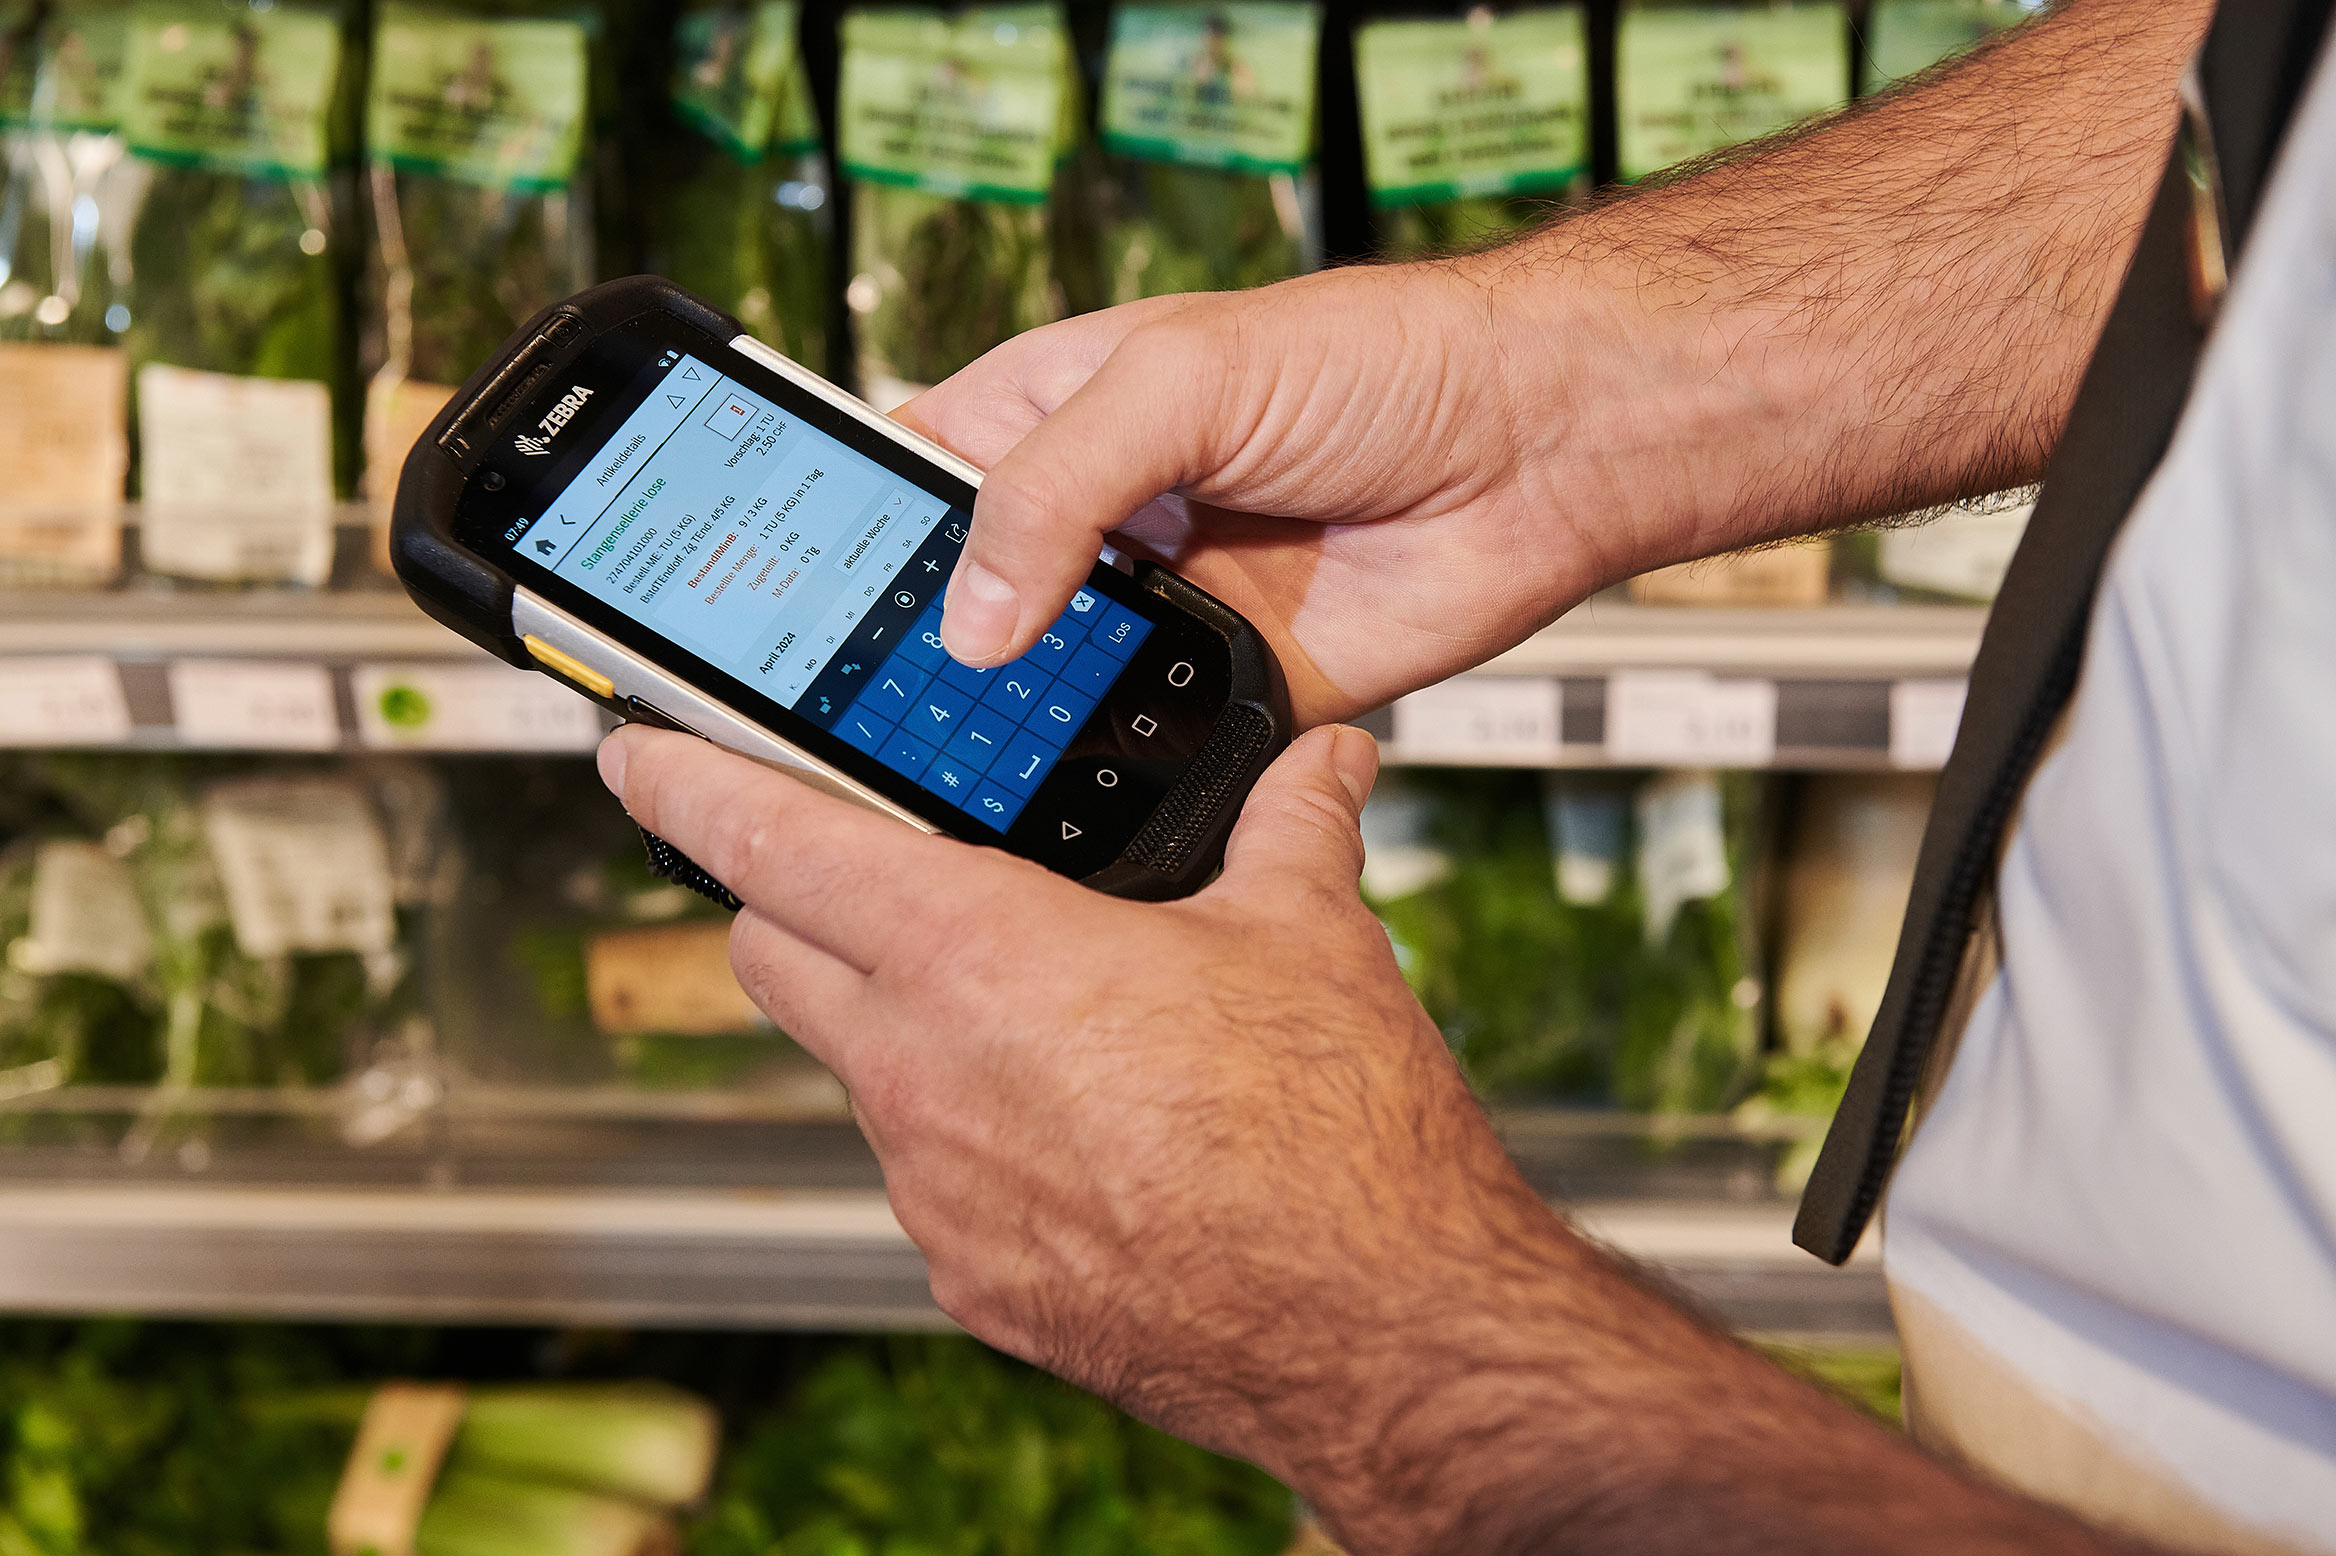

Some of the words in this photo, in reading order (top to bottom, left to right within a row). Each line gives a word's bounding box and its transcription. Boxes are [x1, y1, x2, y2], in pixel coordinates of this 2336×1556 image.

[538, 383, 595, 438] ZEBRA
[758, 411, 776, 426] TU
[754, 434, 778, 457] 2.50
[771, 419, 788, 437] CHF
[755, 424, 767, 433] 1
[722, 430, 762, 469] Vorschlag:
[595, 433, 647, 488] Artikeldetails
[804, 467, 825, 484] Tag
[791, 488, 807, 499] in
[800, 481, 812, 491] 1
[718, 494, 737, 510] KG
[751, 496, 769, 512] KG
[780, 495, 801, 514] KG)
[675, 512, 697, 532] KG)
[709, 506, 726, 522] 4/5
[746, 508, 758, 518] 3
[773, 509, 787, 523] (5
[503, 516, 530, 542] 07:49
[579, 497, 649, 571] Stangensellerie
[640, 477, 667, 500] lose
[688, 519, 715, 544] TEnd:
[737, 519, 749, 529] 9
[762, 518, 779, 533] TU
[668, 527, 683, 541] (5
[758, 531, 770, 541] 1
[783, 530, 801, 547] KG
[842, 538, 871, 570] aktuelle
[863, 513, 891, 540] Woche
[657, 536, 674, 552] TU
[680, 541, 699, 556] Zg
[778, 543, 790, 553] 0
[803, 545, 822, 557] Tg
[604, 526, 659, 585] 274704101000
[686, 530, 740, 589] Bestand/MinB:
[730, 542, 761, 573] Menge:
[799, 554, 811, 564] 0
[621, 549, 665, 595] Bestell-ME:
[745, 554, 781, 592] Zugeteilt:
[703, 570, 737, 606] Bestellte
[770, 566, 802, 599] M-Data:
[803, 657, 818, 672] MO
[824, 634, 837, 645] DI
[844, 609, 856, 621] MI
[862, 584, 876, 598] DO
[882, 561, 895, 573] FR
[901, 538, 914, 550] SA
[919, 514, 932, 527] SO
[921, 631, 944, 650] 8
[1041, 632, 1065, 651] 3
[1107, 621, 1132, 644] Los
[758, 650, 781, 676] April
[774, 630, 797, 655] 2024
[881, 677, 905, 698] 7
[1005, 679, 1032, 700] 2
[928, 703, 951, 723] 4
[1048, 704, 1072, 723] 0
[969, 730, 993, 746] 1
[940, 770, 960, 788] #
[981, 796, 1005, 813] $
